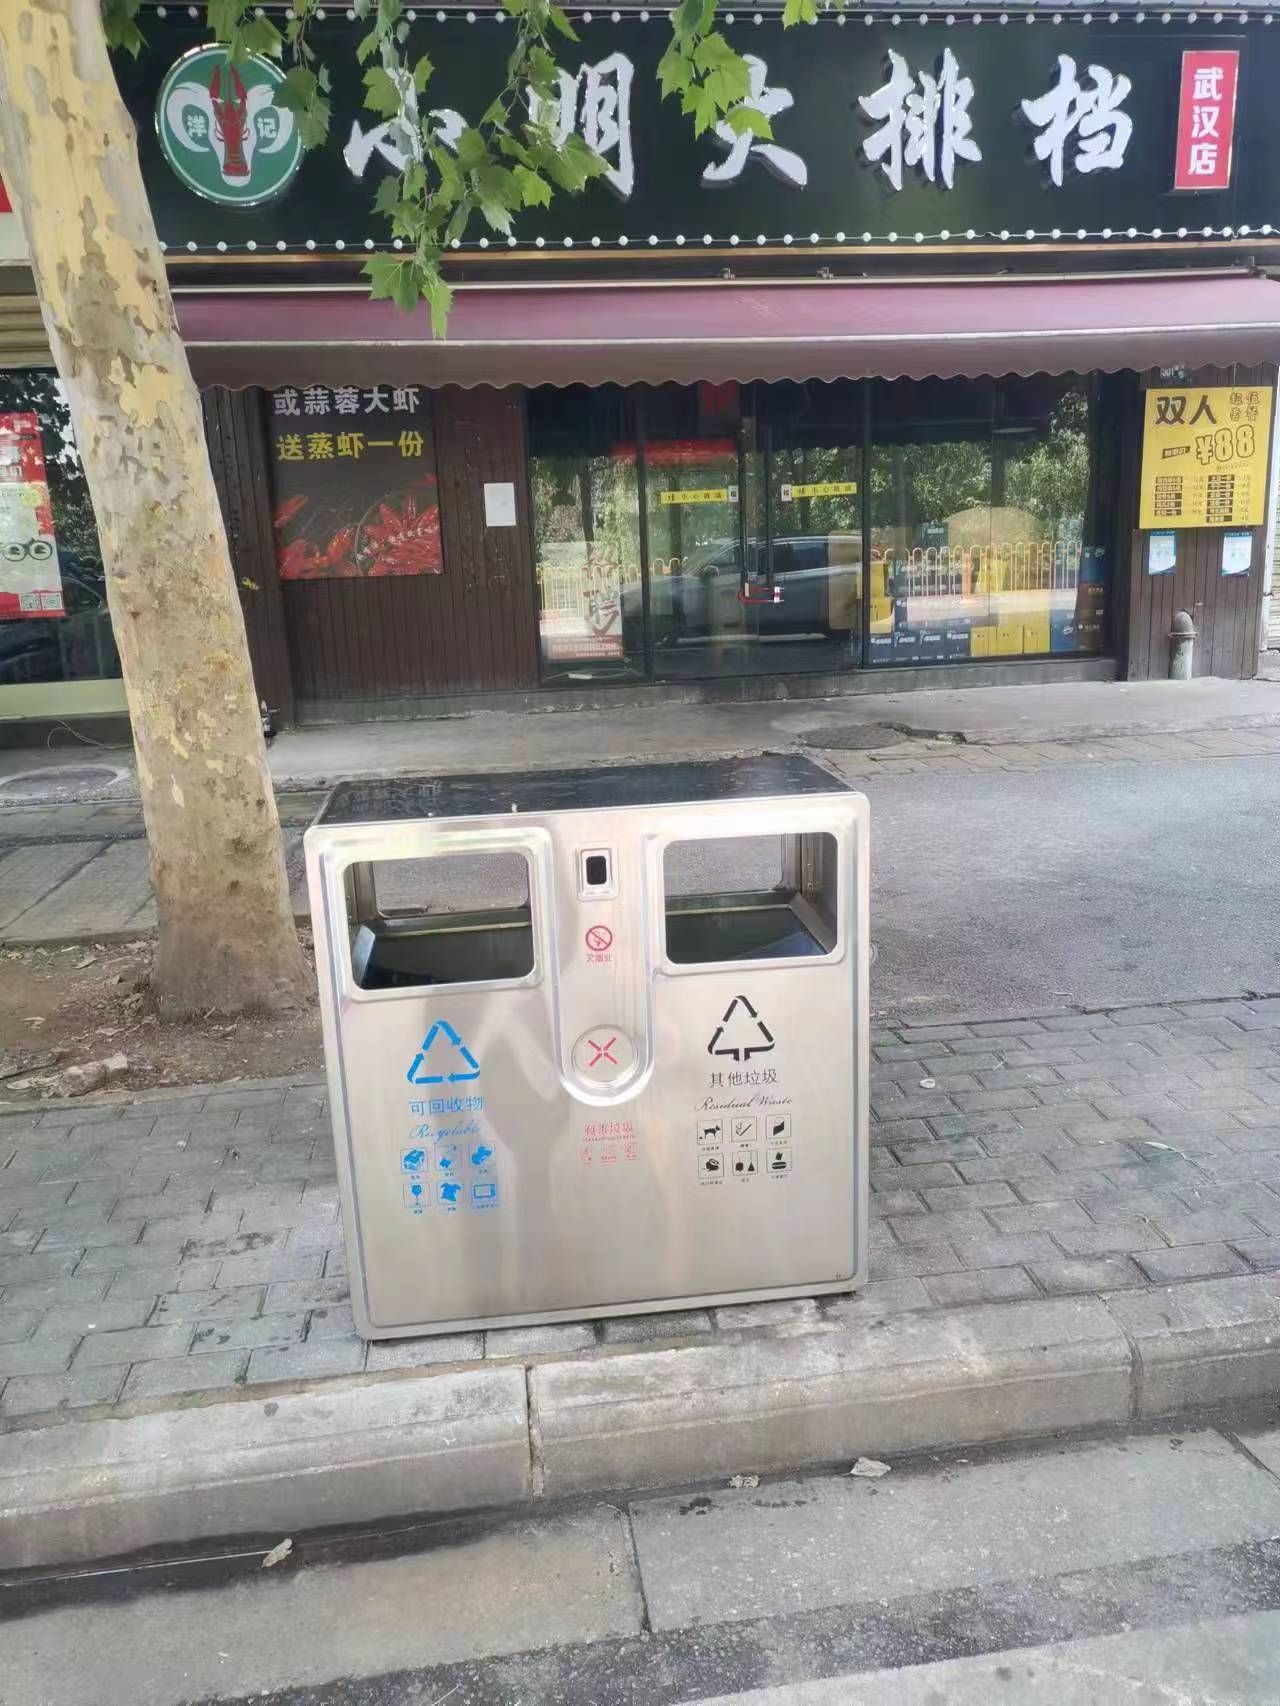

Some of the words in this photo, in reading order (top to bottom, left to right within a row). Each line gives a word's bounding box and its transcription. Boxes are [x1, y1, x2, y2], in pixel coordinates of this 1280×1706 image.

[1187, 66, 1223, 176] 武汉店
[273, 387, 420, 416] 或蒜蓉大虾
[1155, 395, 1218, 425] 双人
[276, 431, 424, 461] 送蒸虾一份
[1195, 424, 1256, 465] ¥88
[709, 1068, 778, 1088] 其他垃圾
[409, 1096, 484, 1116] 可回收物
[695, 1094, 756, 1112] Residual
[756, 1094, 793, 1106] Waste
